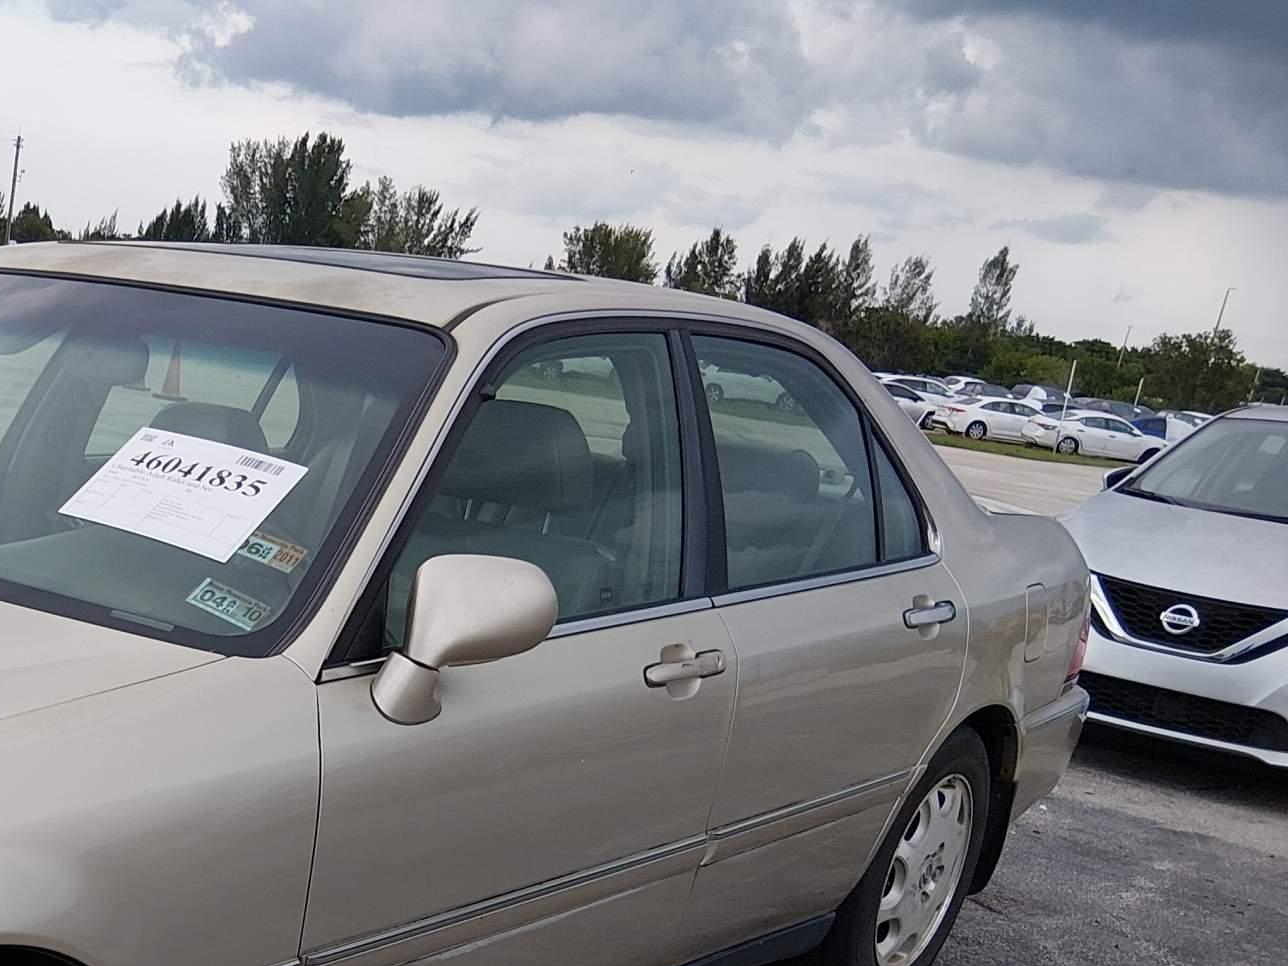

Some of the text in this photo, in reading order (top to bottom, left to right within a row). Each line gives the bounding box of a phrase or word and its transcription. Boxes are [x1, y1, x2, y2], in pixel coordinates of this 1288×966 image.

[130, 450, 268, 497] 46041835
[199, 589, 228, 609] 04
[242, 606, 262, 622] 10
[1163, 614, 1194, 625] NISSAN
